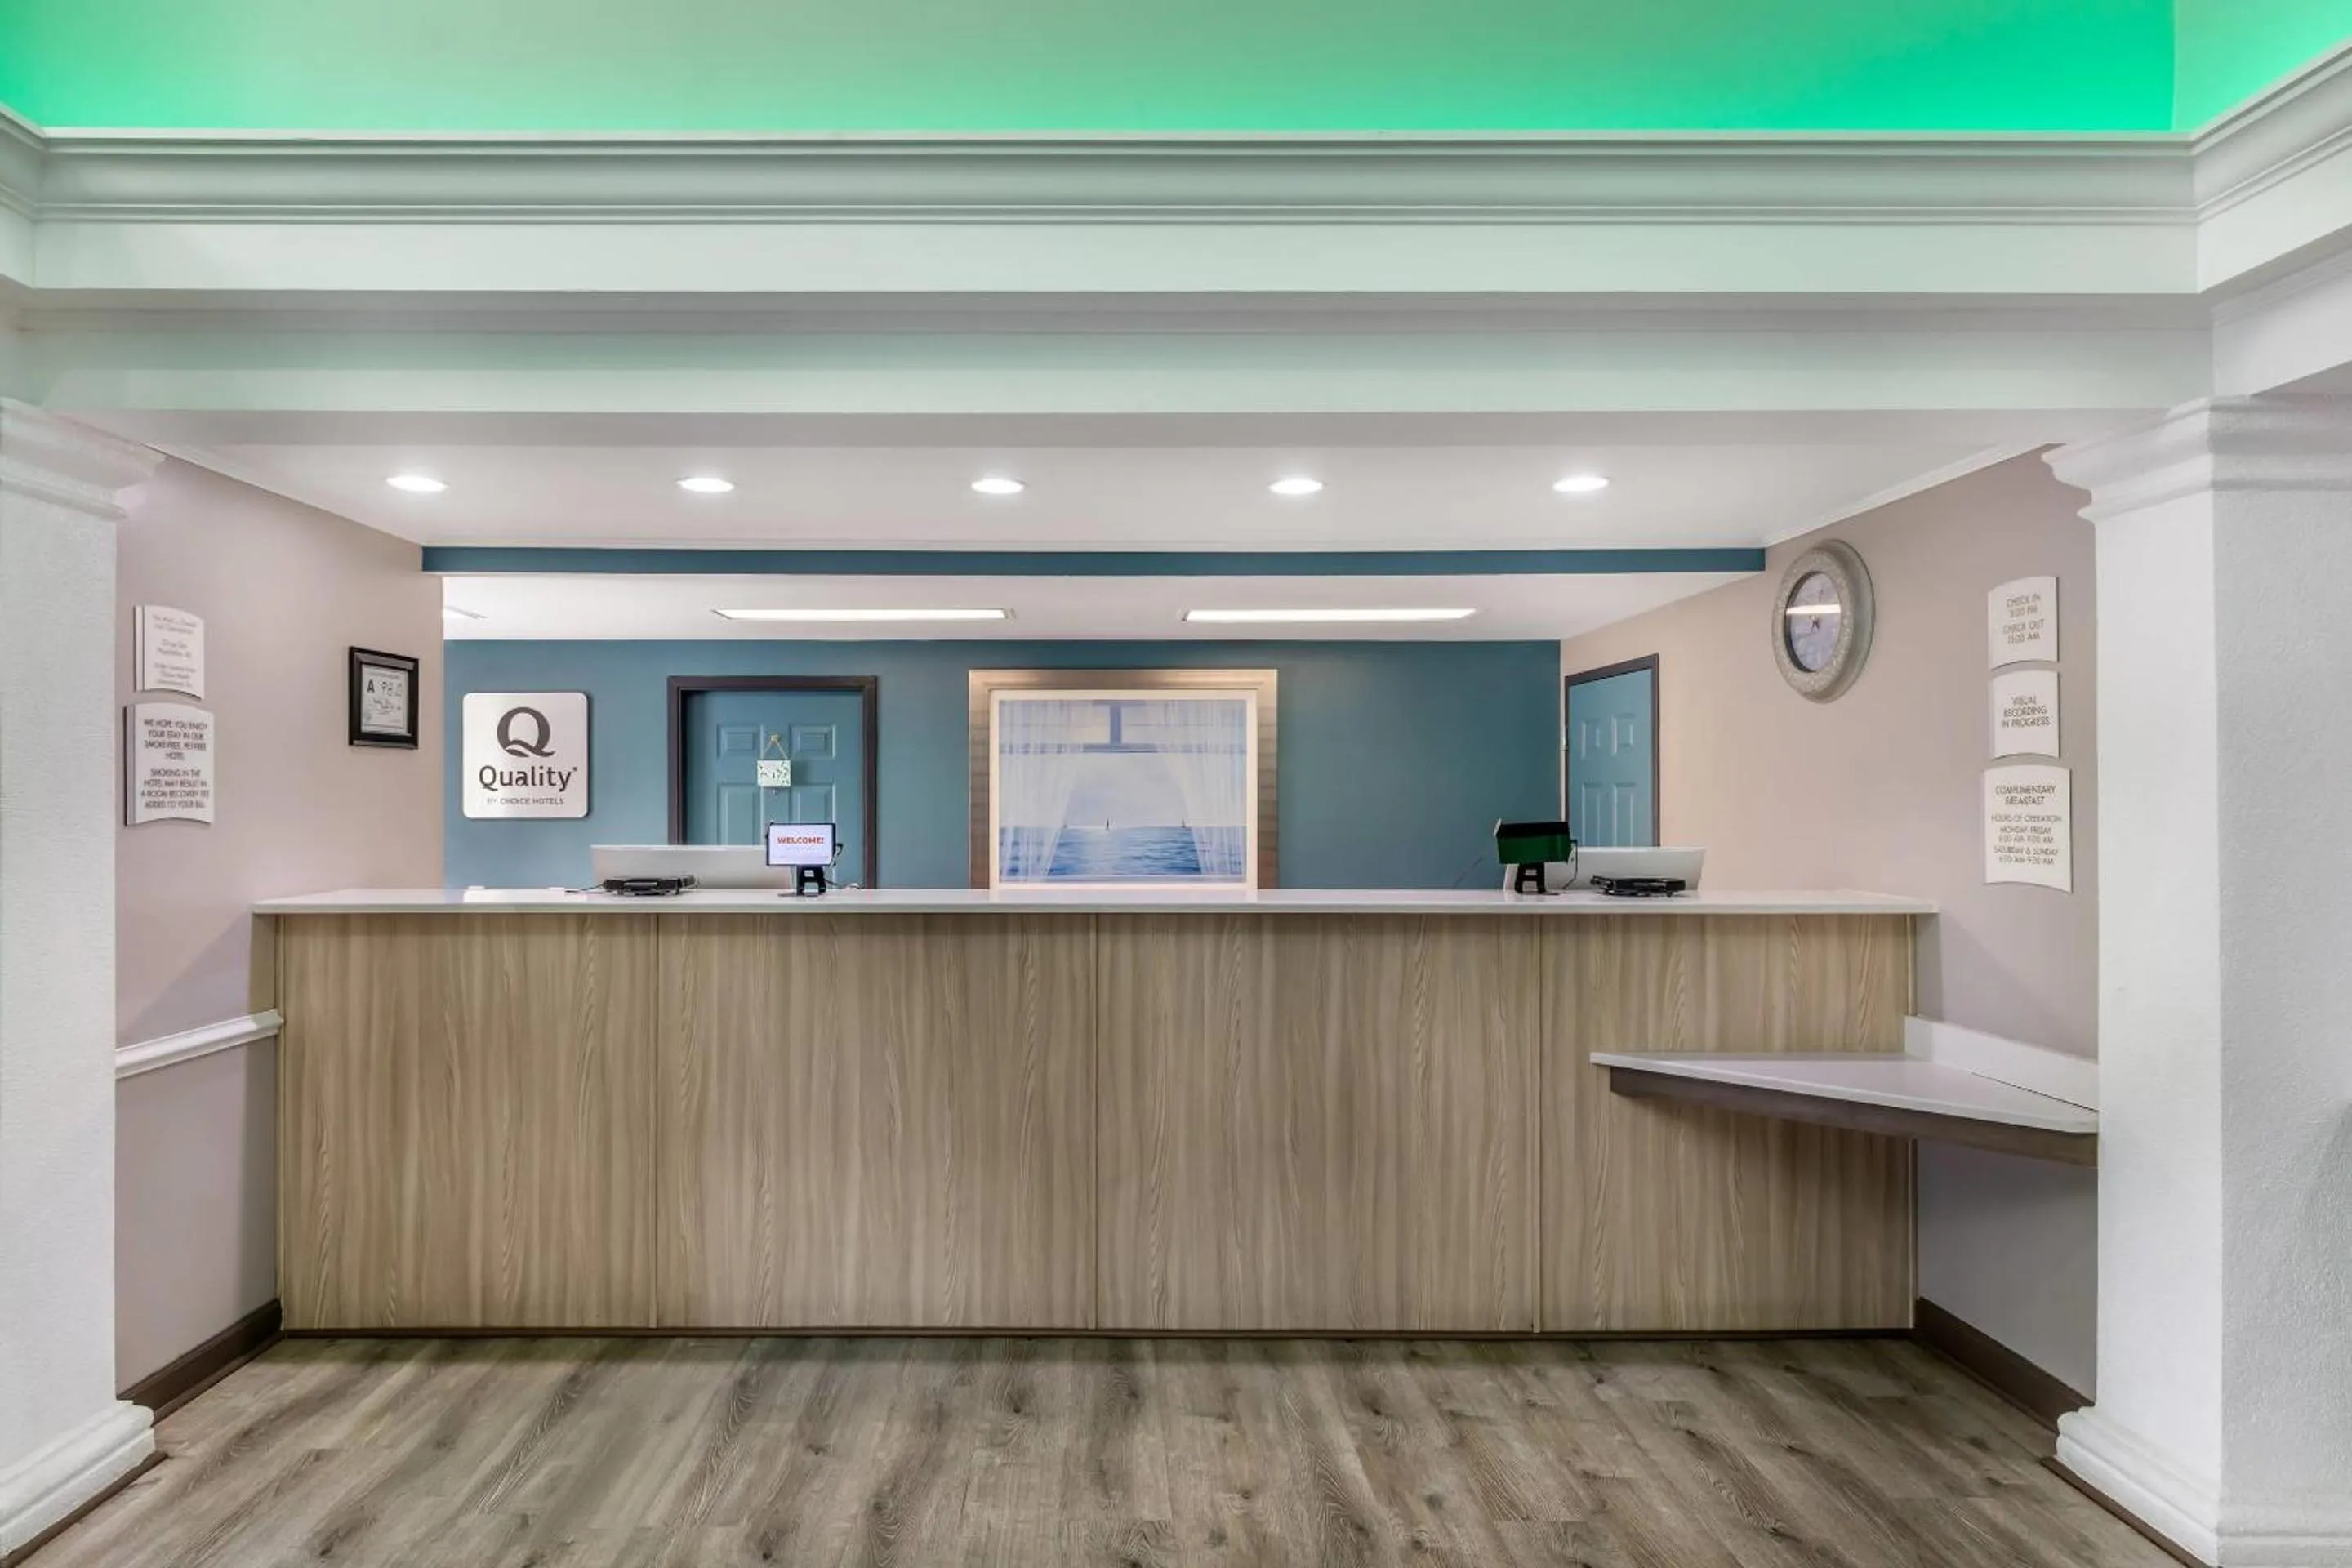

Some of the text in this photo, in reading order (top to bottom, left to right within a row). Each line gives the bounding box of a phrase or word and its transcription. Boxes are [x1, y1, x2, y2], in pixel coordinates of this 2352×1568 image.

[2002, 619, 2045, 635] CHECK OUT
[2027, 632, 2041, 641] AM
[367, 679, 375, 693] A
[2004, 705, 2047, 717] RECORDING
[2011, 716, 2051, 728] PROGRESS
[148, 729, 165, 738] YOUR
[497, 706, 556, 758] Q
[479, 765, 572, 792] Quality
[500, 797, 530, 805] CHOICE
[532, 797, 564, 805] HOTELS
[2005, 795, 2045, 805] BREAKFAST
[777, 836, 824, 844] WELCOME!
